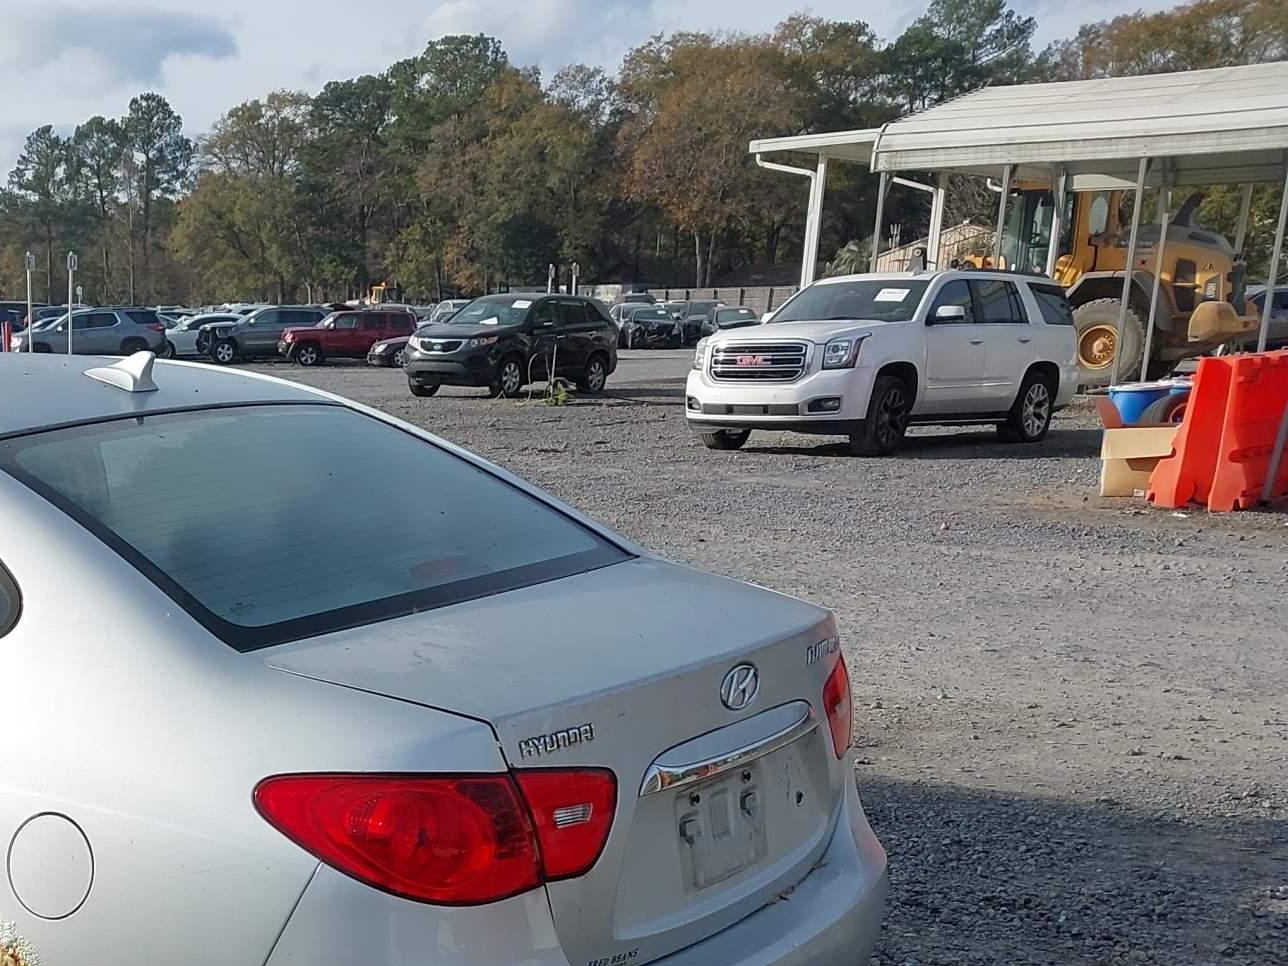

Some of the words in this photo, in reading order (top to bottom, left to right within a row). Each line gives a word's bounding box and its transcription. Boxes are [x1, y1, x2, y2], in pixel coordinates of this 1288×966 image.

[737, 355, 772, 365] GMC
[519, 723, 594, 760] HYUNDAI
[611, 948, 639, 964] BEANS
